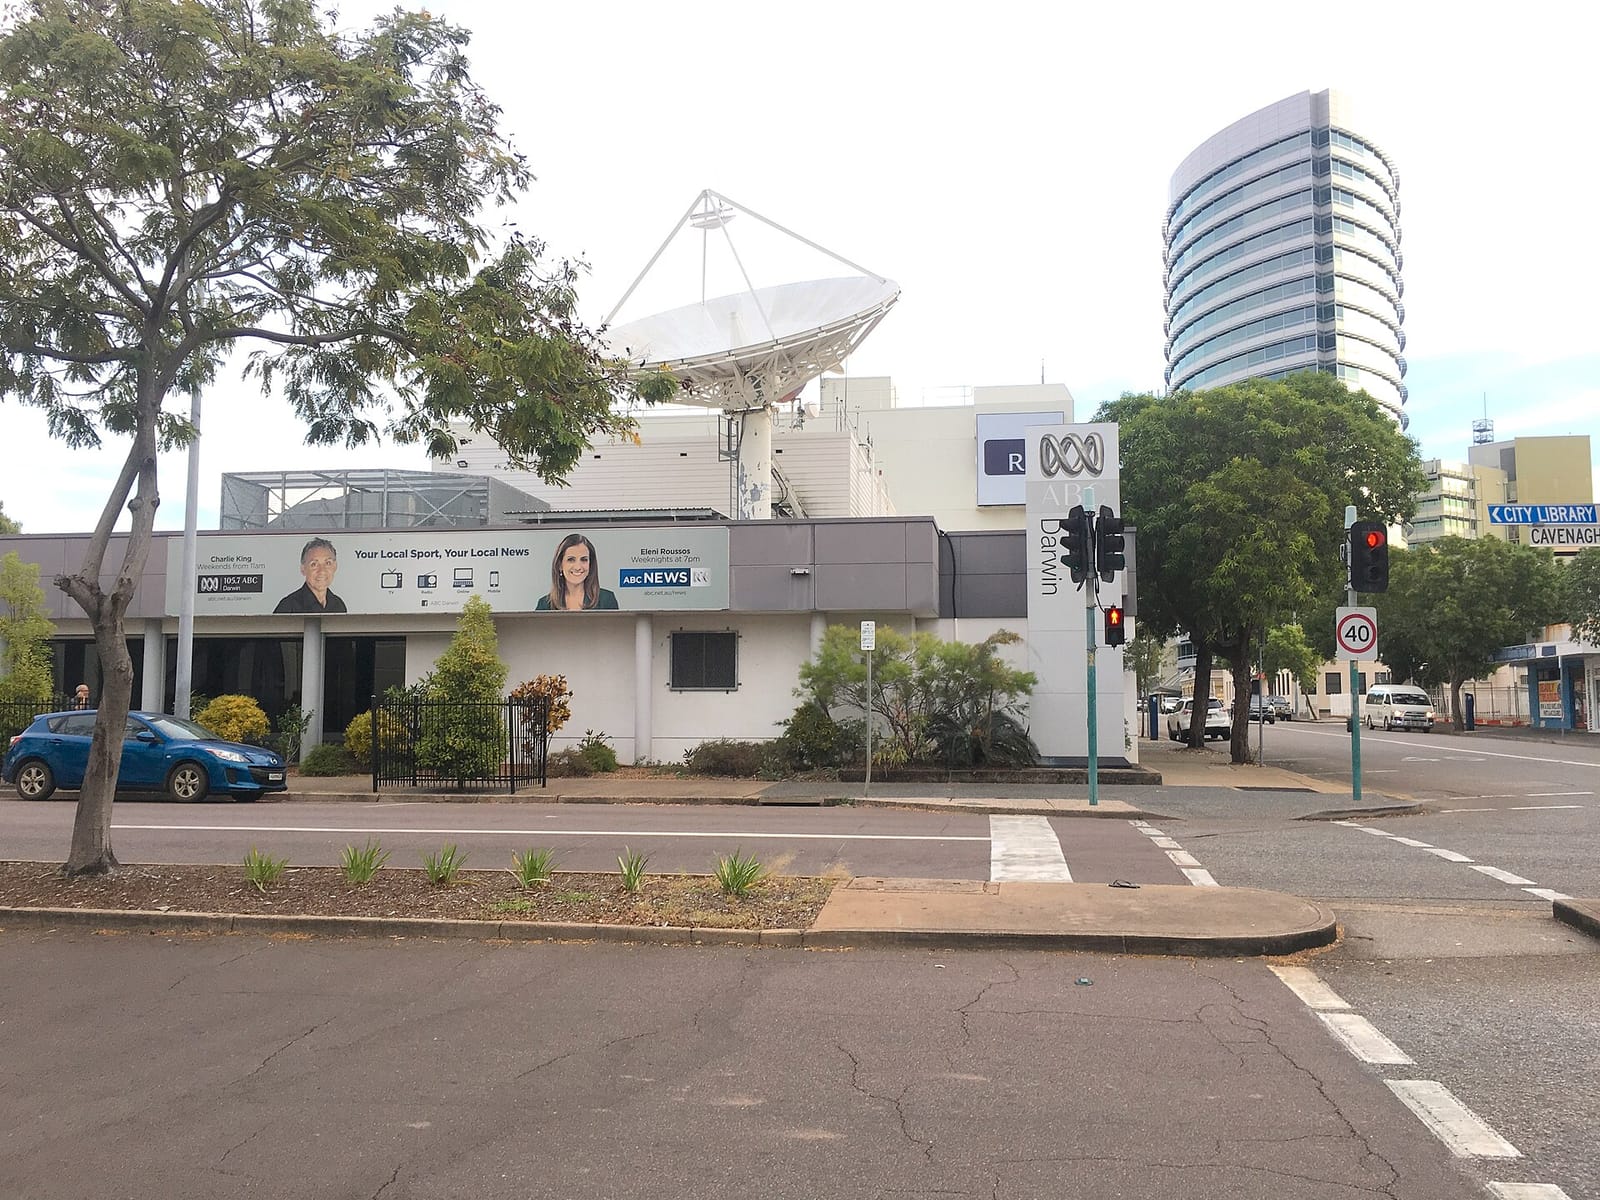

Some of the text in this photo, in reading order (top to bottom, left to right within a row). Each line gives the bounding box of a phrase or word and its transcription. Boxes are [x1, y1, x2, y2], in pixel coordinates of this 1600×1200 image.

[1504, 506, 1593, 522] CITY LIBRARY
[354, 548, 530, 560] Your Local Sport, Your Local News
[1040, 518, 1062, 595] Darwin
[644, 572, 688, 584] NEWS
[1344, 625, 1369, 642] 40
